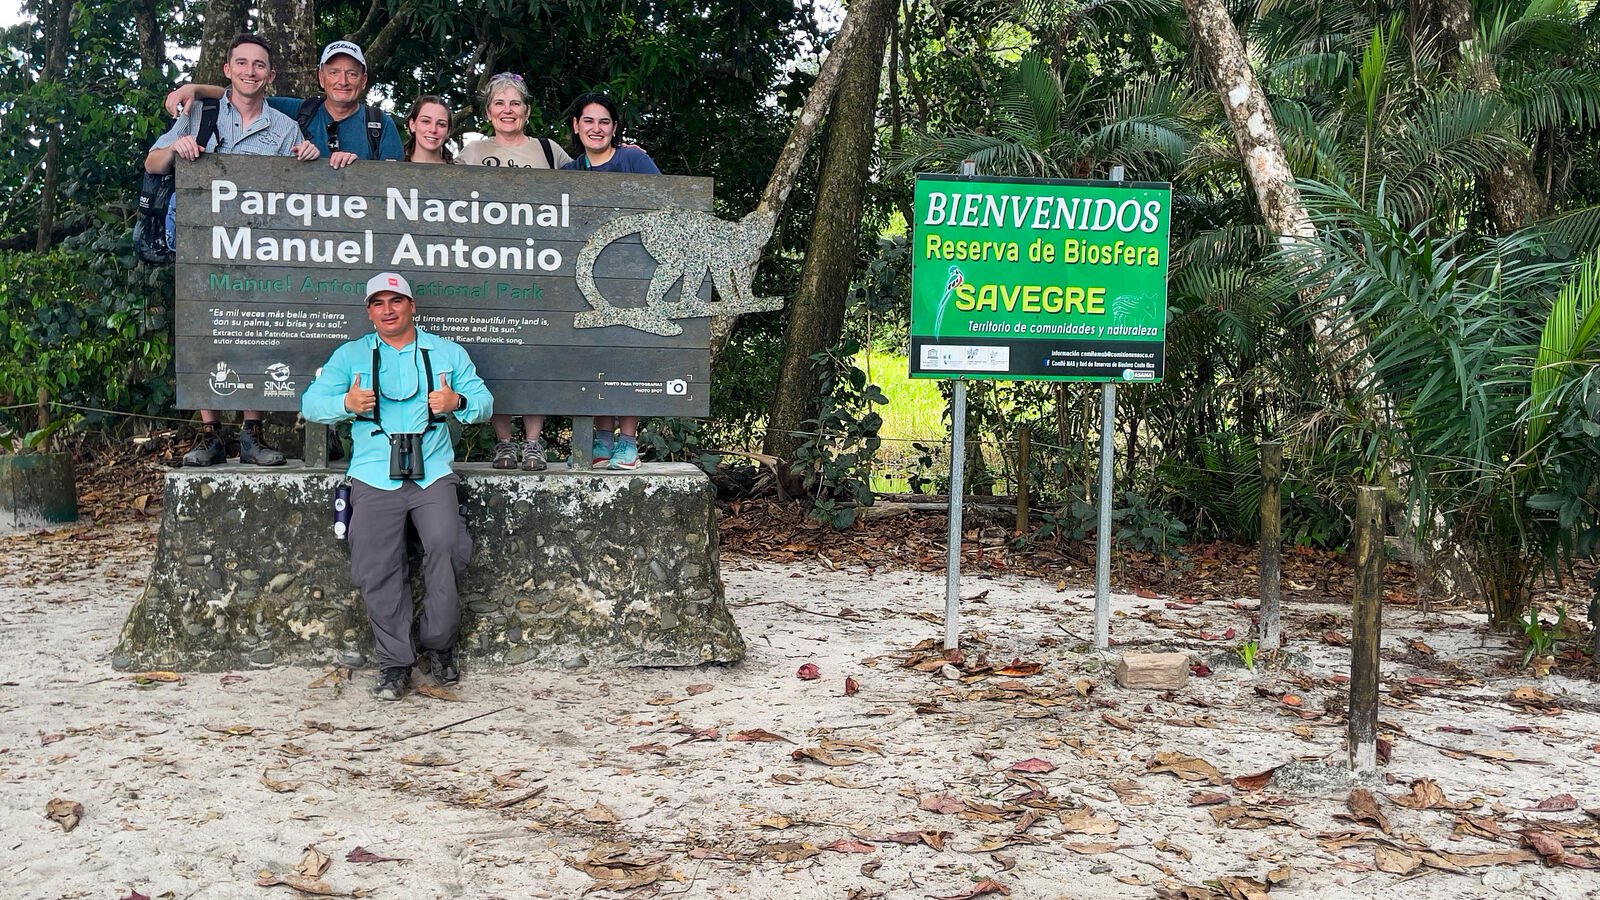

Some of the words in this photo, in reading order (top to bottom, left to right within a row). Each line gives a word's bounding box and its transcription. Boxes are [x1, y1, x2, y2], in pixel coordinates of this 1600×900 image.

[211, 180, 368, 226] Parque
[386, 187, 570, 227] Nacional
[924, 192, 1161, 233] BIENVENIDOS
[212, 226, 373, 264] Manuel
[391, 233, 562, 272] Antonio
[926, 234, 1020, 262] Reserva
[1028, 238, 1055, 263] de
[1064, 238, 1160, 266] Biosfera
[209, 272, 291, 292] Manuel
[301, 275, 367, 294] Anton
[410, 280, 488, 297] ational
[496, 282, 543, 300] Park
[955, 284, 1106, 314] SAVEGRE
[243, 318, 272, 328] palma,
[286, 319, 307, 328] brisa
[268, 310, 284, 318] más
[286, 310, 307, 318] bella
[322, 312, 345, 320] tierra
[470, 316, 506, 324] beautiful
[507, 318, 520, 326] my
[522, 317, 540, 325] land
[540, 318, 550, 326] is,
[212, 328, 243, 336] Extracto
[442, 324, 470, 332] breeze
[968, 321, 1011, 333] Territorio
[1014, 322, 1026, 333] de
[1030, 322, 1095, 335] comunidades
[1098, 325, 1104, 337] y
[1107, 324, 1158, 336] naturaleza
[264, 381, 295, 391] SINAC
